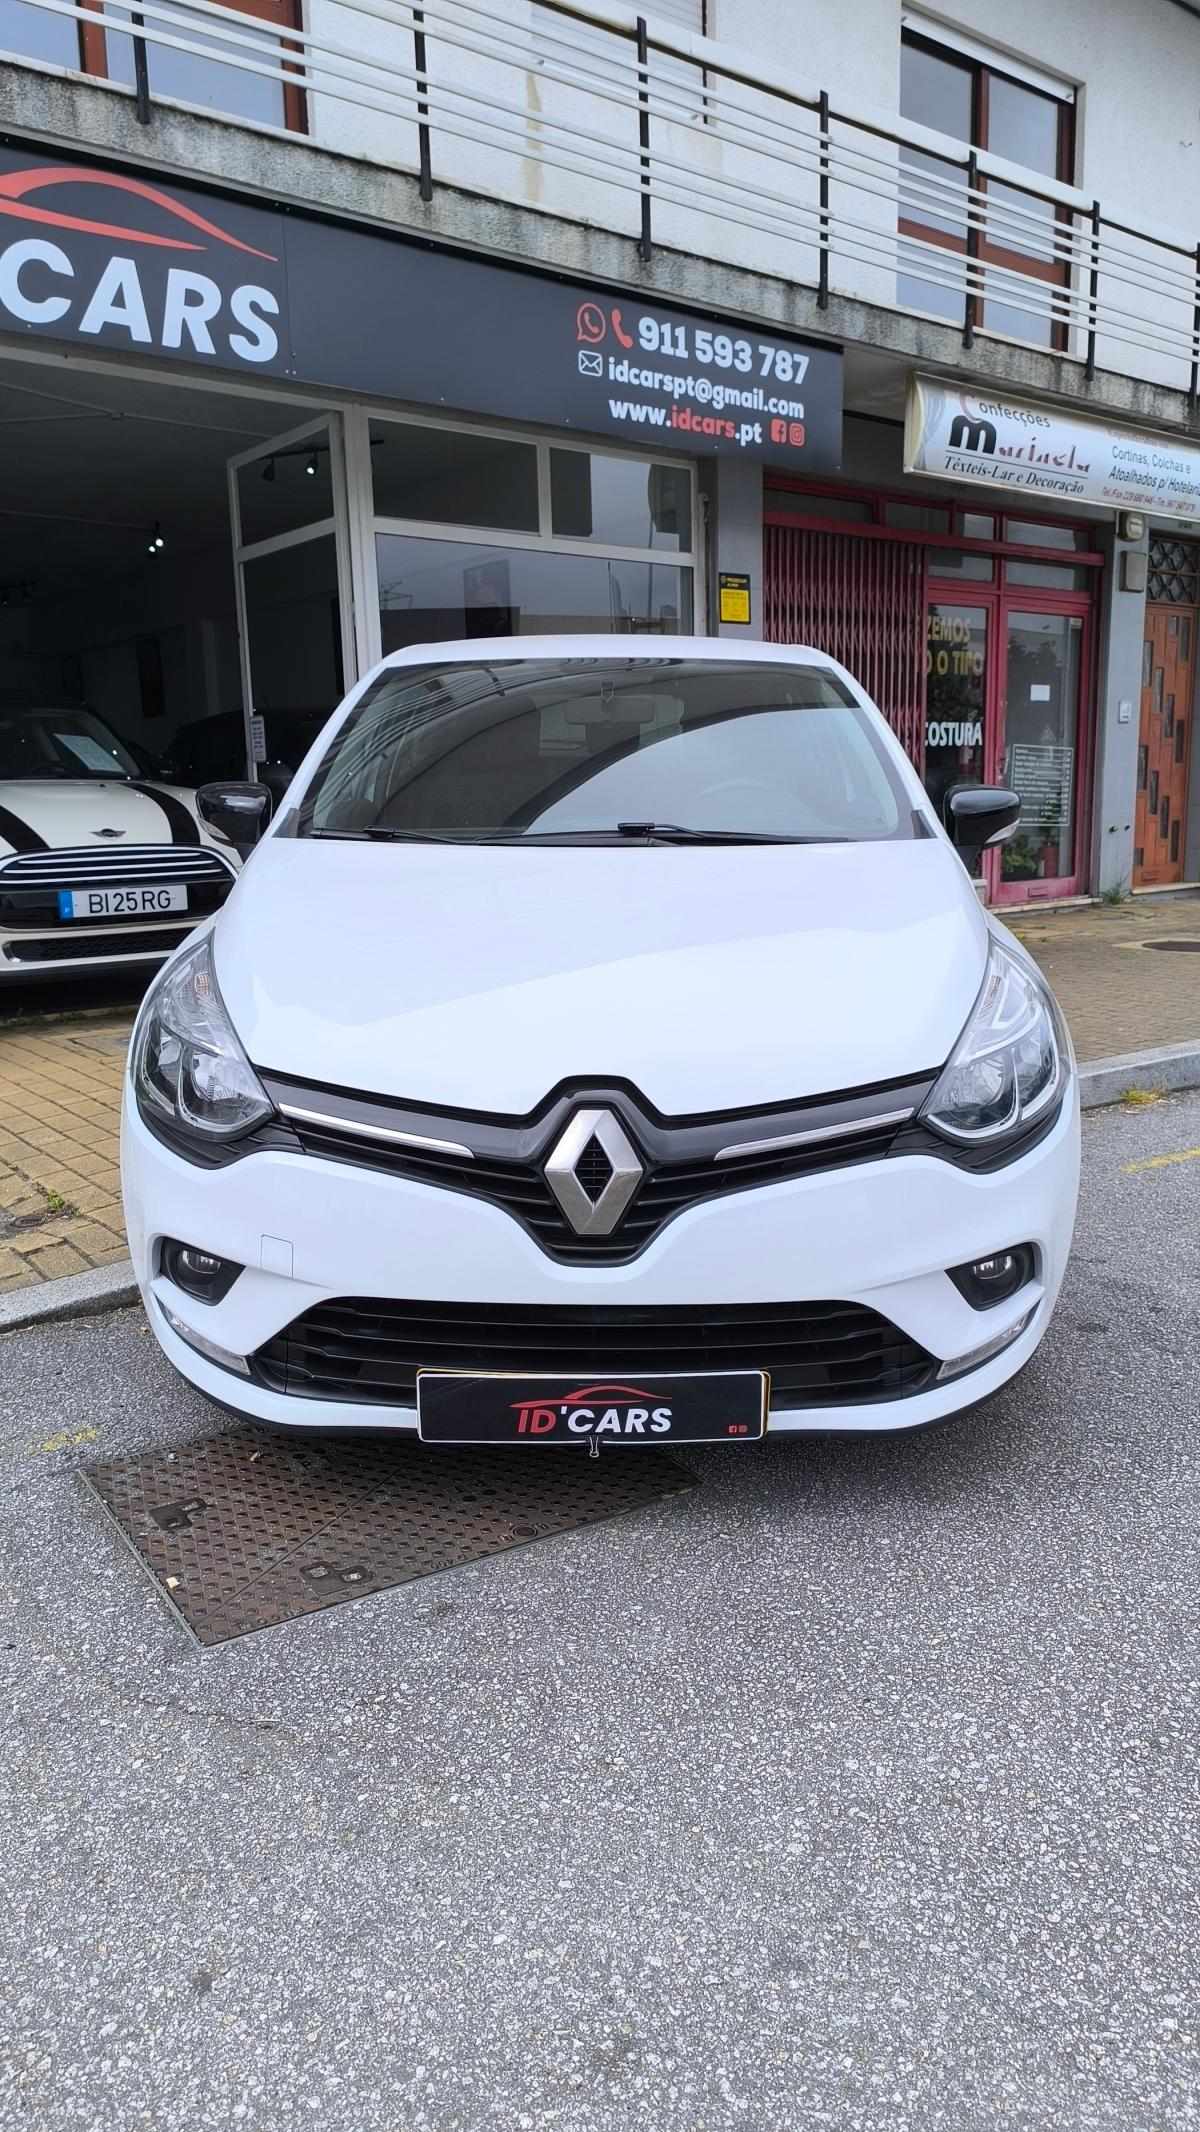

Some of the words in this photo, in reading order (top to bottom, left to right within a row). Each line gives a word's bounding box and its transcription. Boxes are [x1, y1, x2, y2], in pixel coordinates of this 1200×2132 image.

[0, 238, 280, 362] CARS
[638, 317, 688, 359] 911
[695, 329, 752, 373] 593
[758, 345, 809, 385] 787
[608, 356, 805, 419] idcarspt@gmail.com
[608, 399, 763, 446] www.idcars.pt
